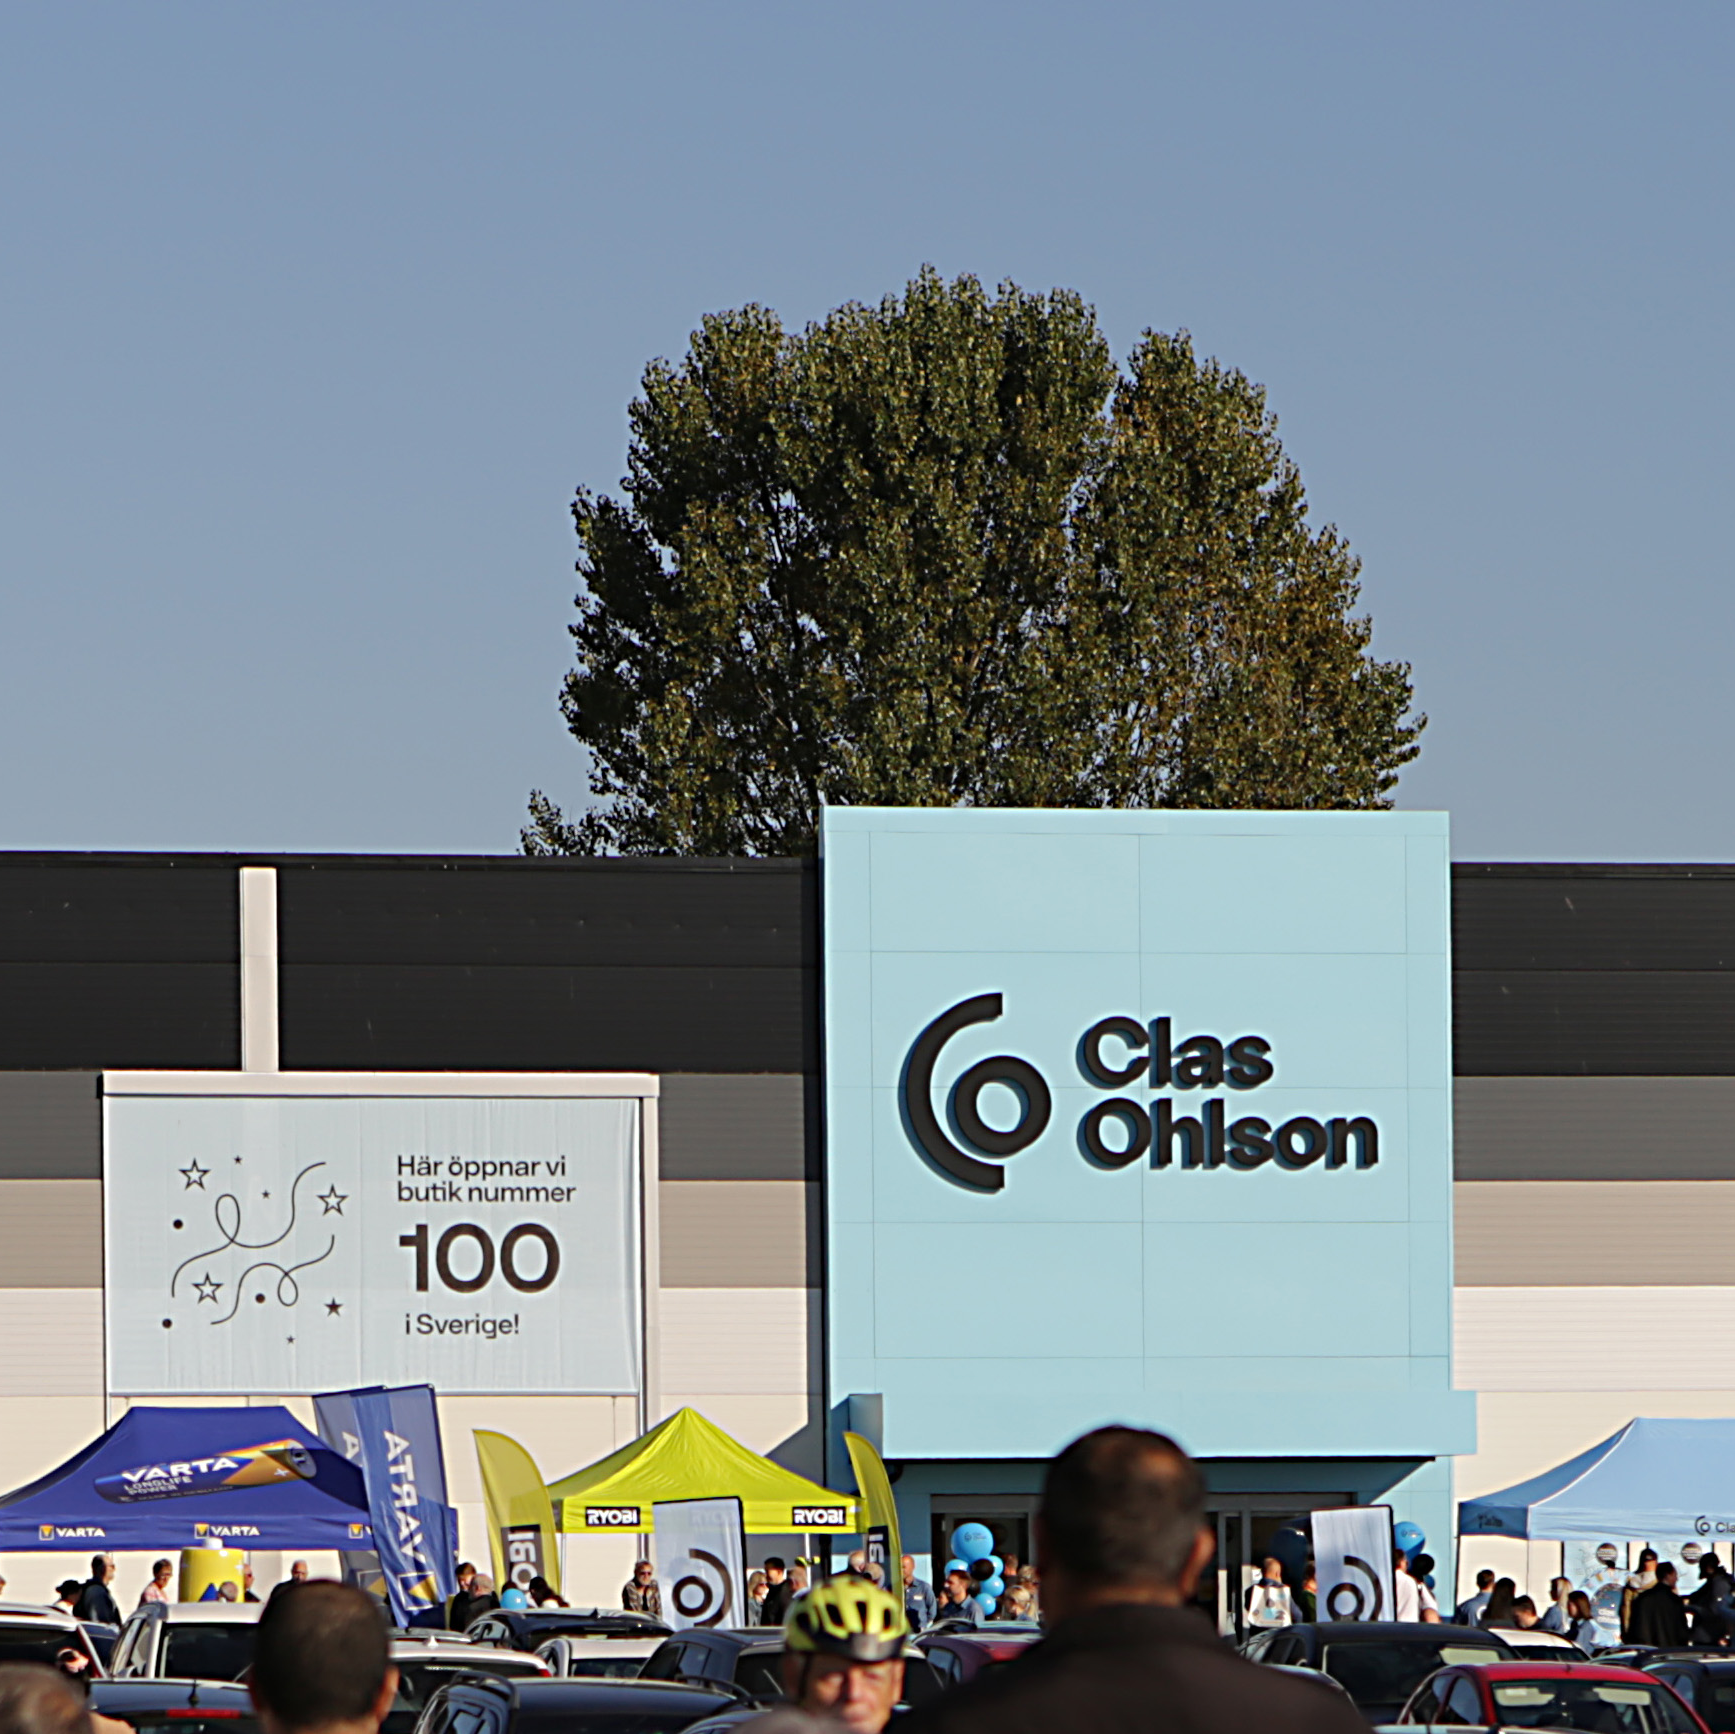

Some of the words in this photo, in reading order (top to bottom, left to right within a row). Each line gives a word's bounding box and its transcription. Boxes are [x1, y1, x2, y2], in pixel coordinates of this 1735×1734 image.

[1075, 1015, 1274, 1090] Clas
[1076, 1097, 1379, 1171] Ohlson
[397, 1155, 444, 1177] Här
[448, 1156, 542, 1182] öppnar
[546, 1155, 566, 1177] vi
[397, 1181, 463, 1203] butik
[468, 1184, 577, 1203] nummer
[399, 1222, 561, 1294] 100
[404, 1314, 412, 1336] i
[416, 1313, 520, 1340] Sverige!
[122, 1457, 239, 1483] VARTA
[123, 1475, 192, 1490] LONGLIFE
[587, 1508, 638, 1525] RYOBI
[793, 1508, 844, 1525] RYOBI
[55, 1526, 106, 1538] VARTA
[210, 1525, 261, 1537] VARTA
